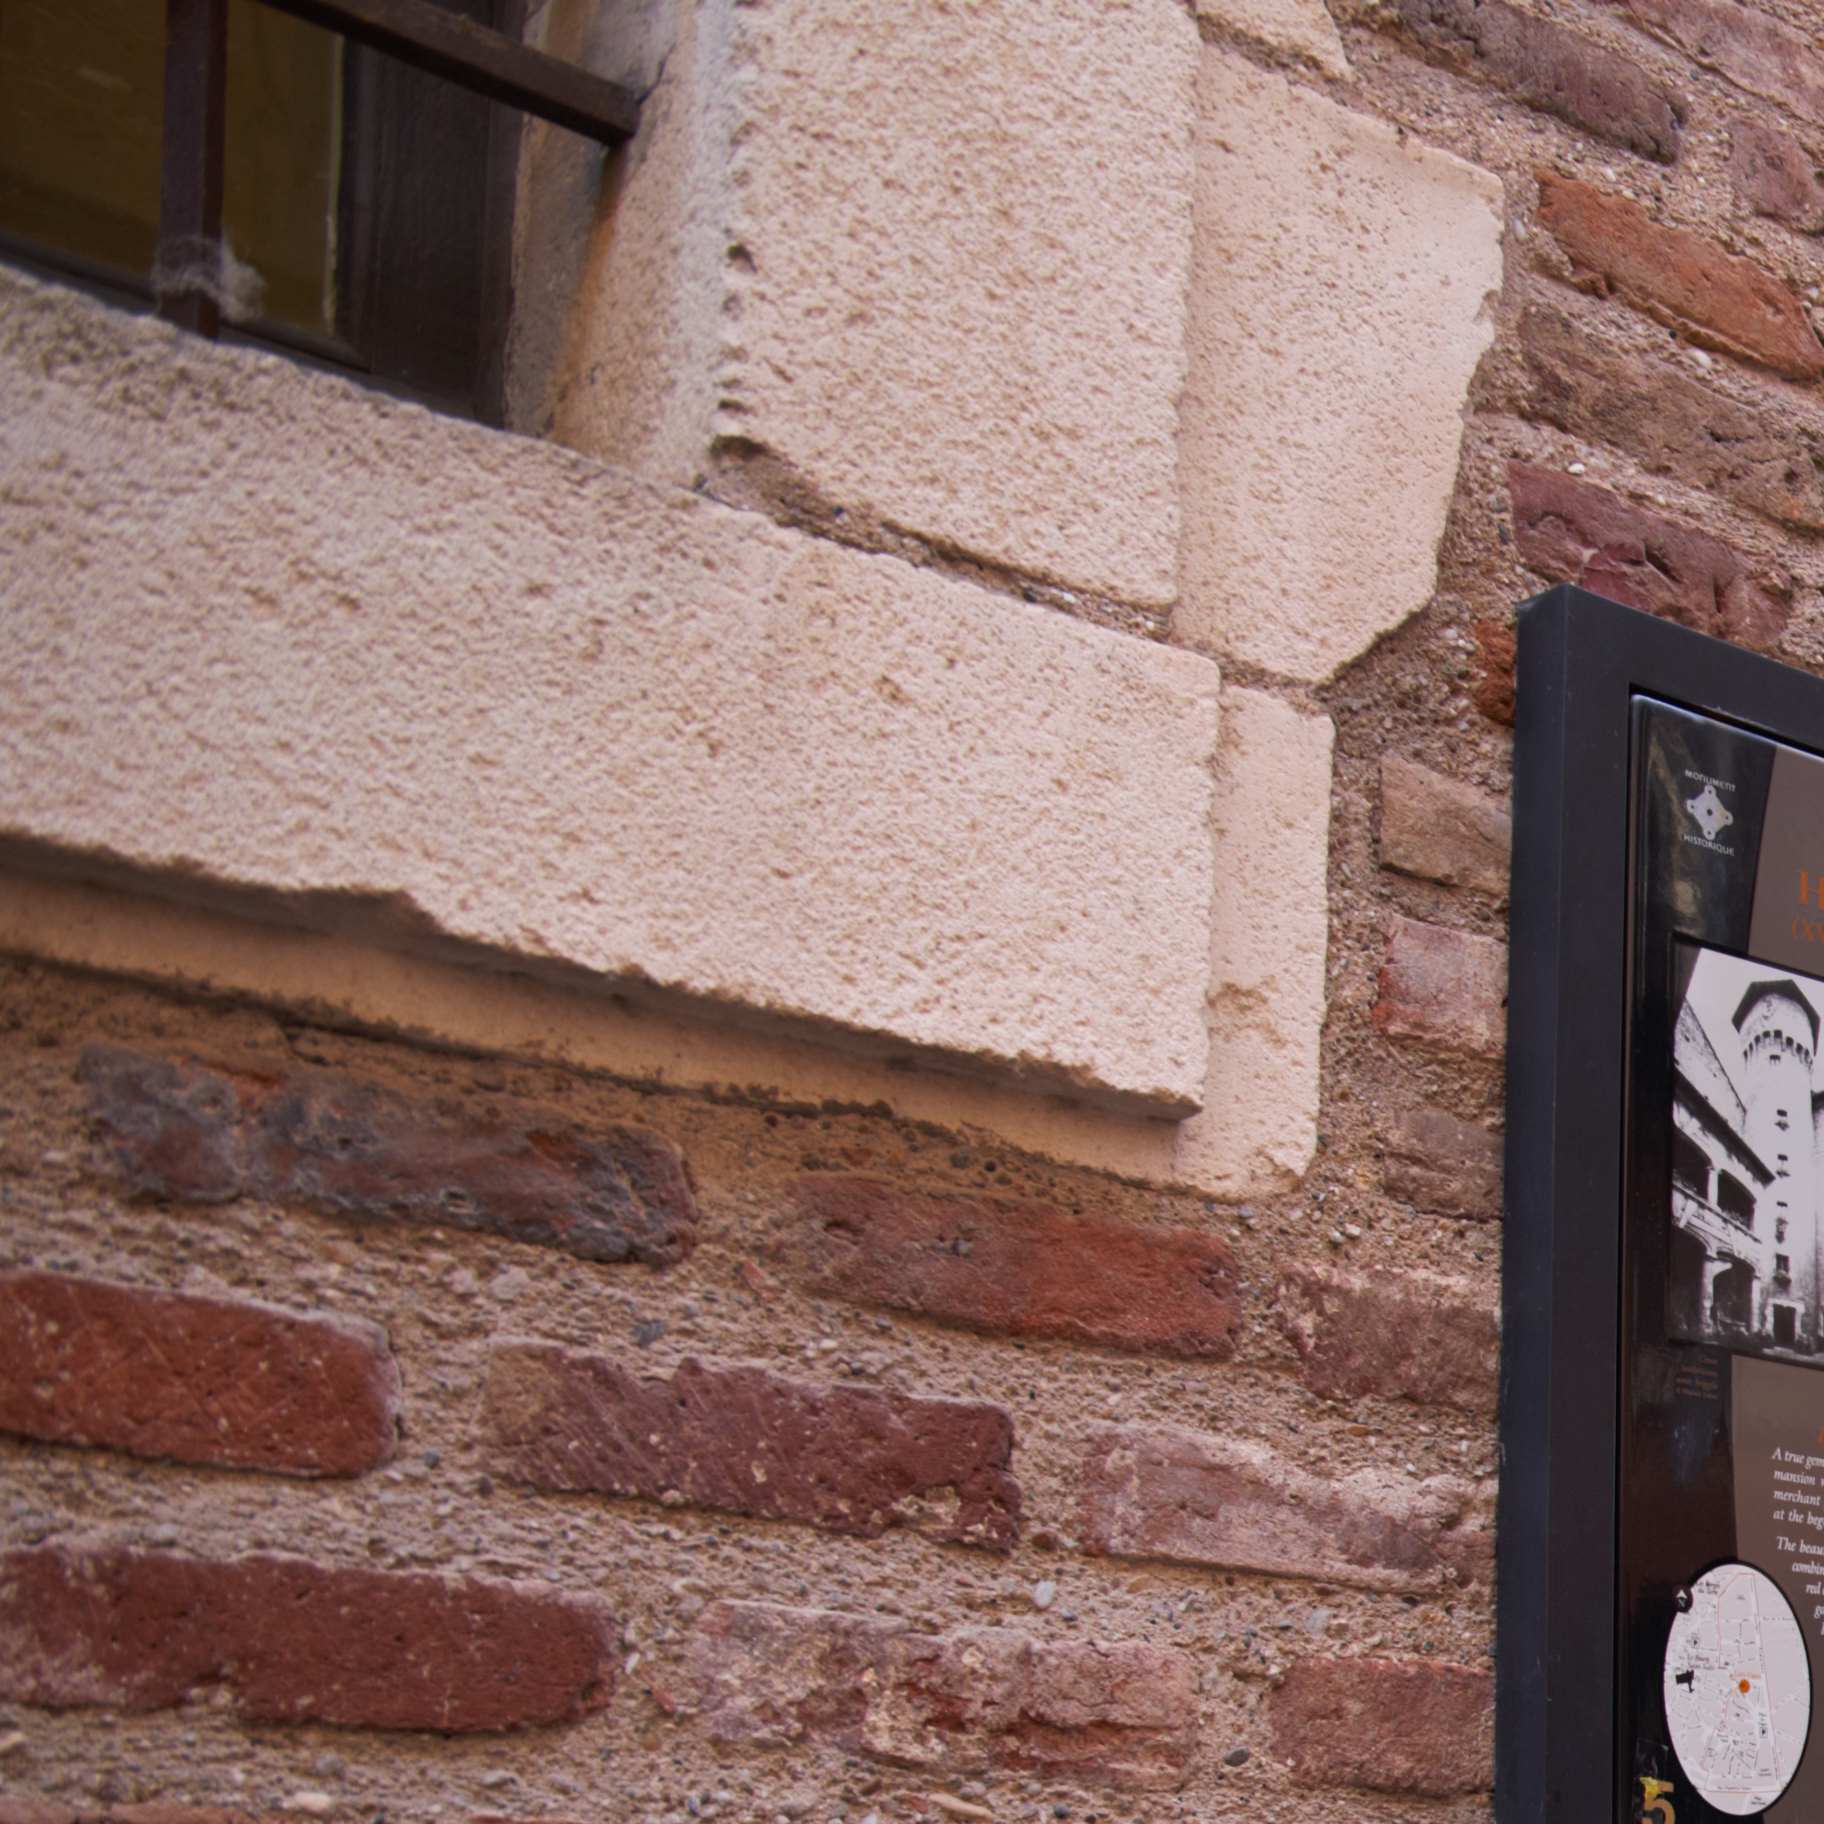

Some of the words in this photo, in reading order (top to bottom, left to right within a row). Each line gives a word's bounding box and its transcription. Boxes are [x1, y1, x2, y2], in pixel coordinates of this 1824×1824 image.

[1684, 769, 1736, 793] MONUMENT
[1683, 832, 1736, 857] HISTORIQUE
[1772, 1447, 1782, 1461] A
[1784, 1451, 1805, 1465] true
[1804, 1456, 1824, 1470] gem
[1774, 1470, 1815, 1486] mansion
[1773, 1490, 1820, 1506] merchant
[1773, 1510, 1784, 1522] at
[1788, 1509, 1804, 1524] the
